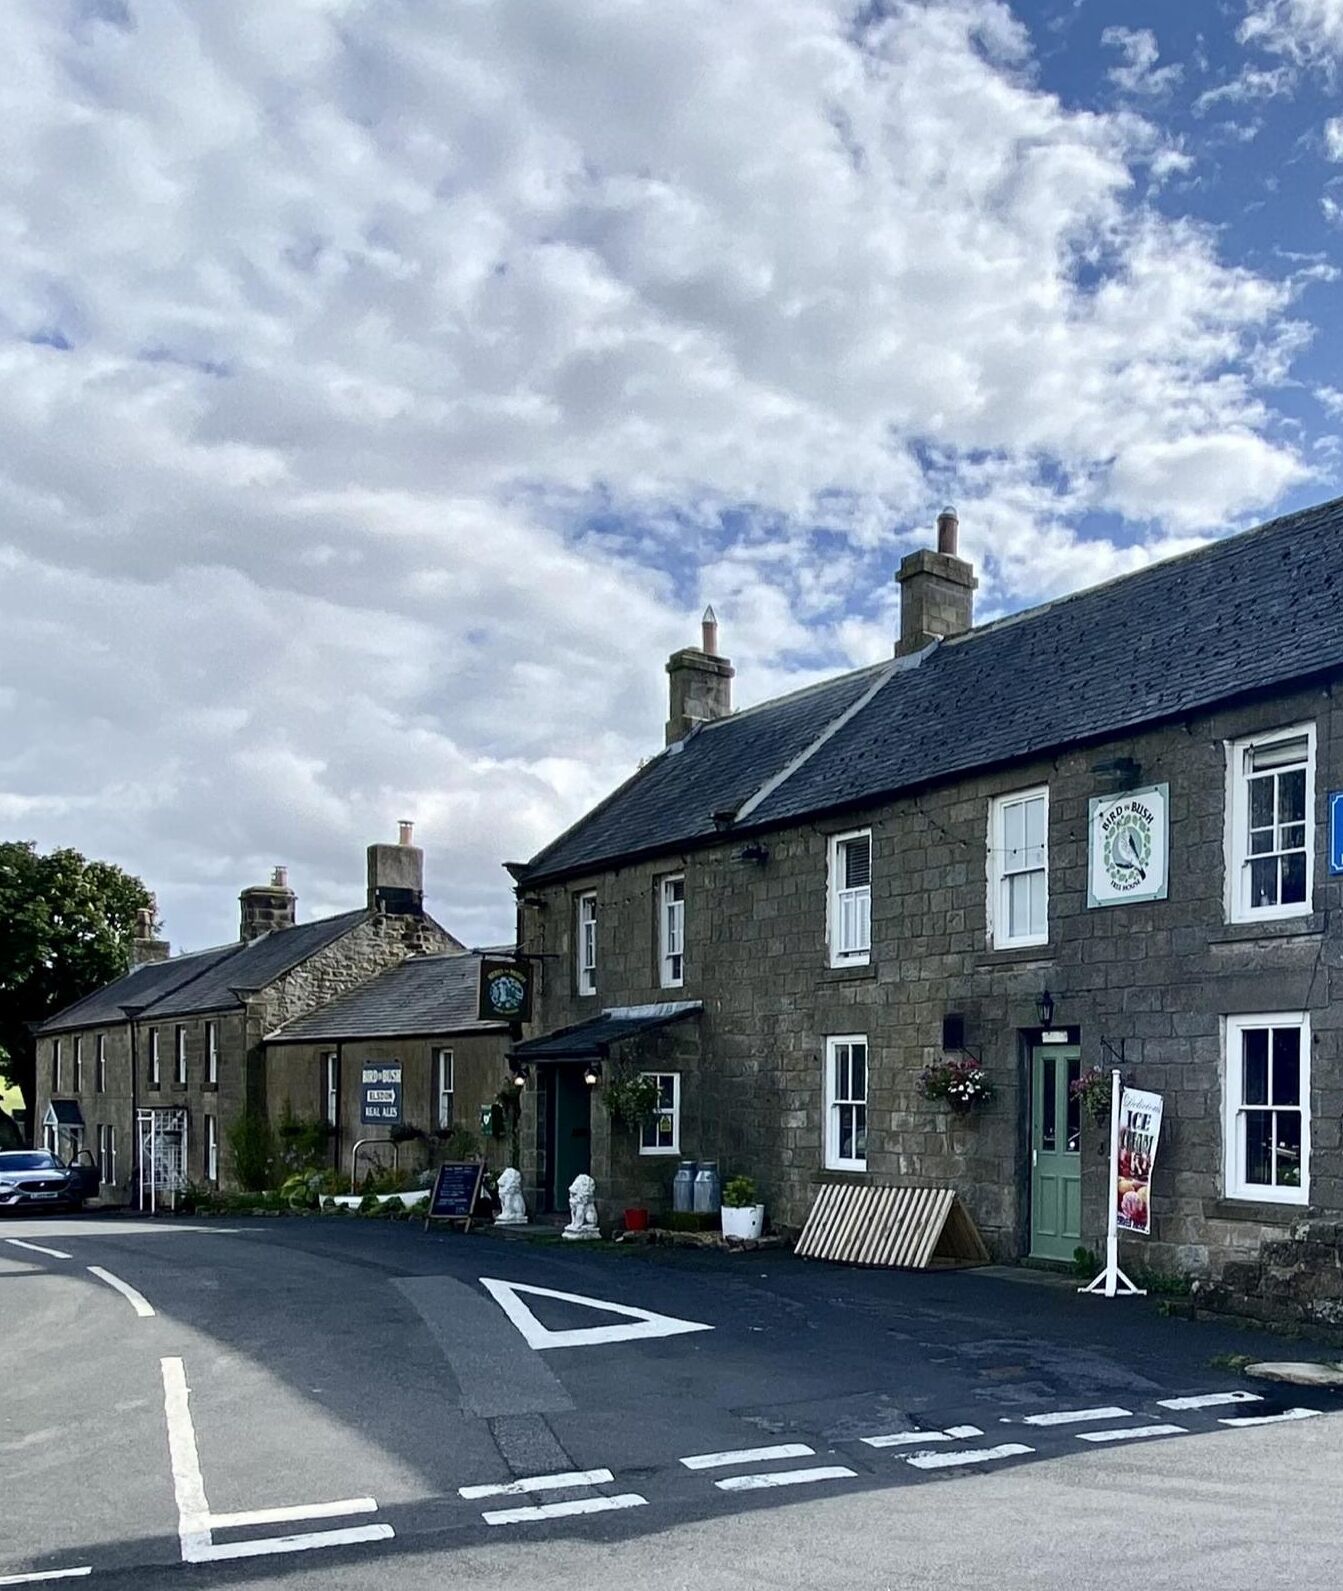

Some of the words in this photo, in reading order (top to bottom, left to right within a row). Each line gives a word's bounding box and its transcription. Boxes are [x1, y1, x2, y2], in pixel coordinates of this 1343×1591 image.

[1102, 806, 1123, 831] BIRD
[1131, 801, 1154, 824] BUSH
[363, 1070, 377, 1083] BIRD
[383, 1070, 401, 1083] BUSH
[366, 1107, 380, 1117] REAL
[382, 1107, 397, 1117] ALES
[1127, 1110, 1151, 1131] ICE
